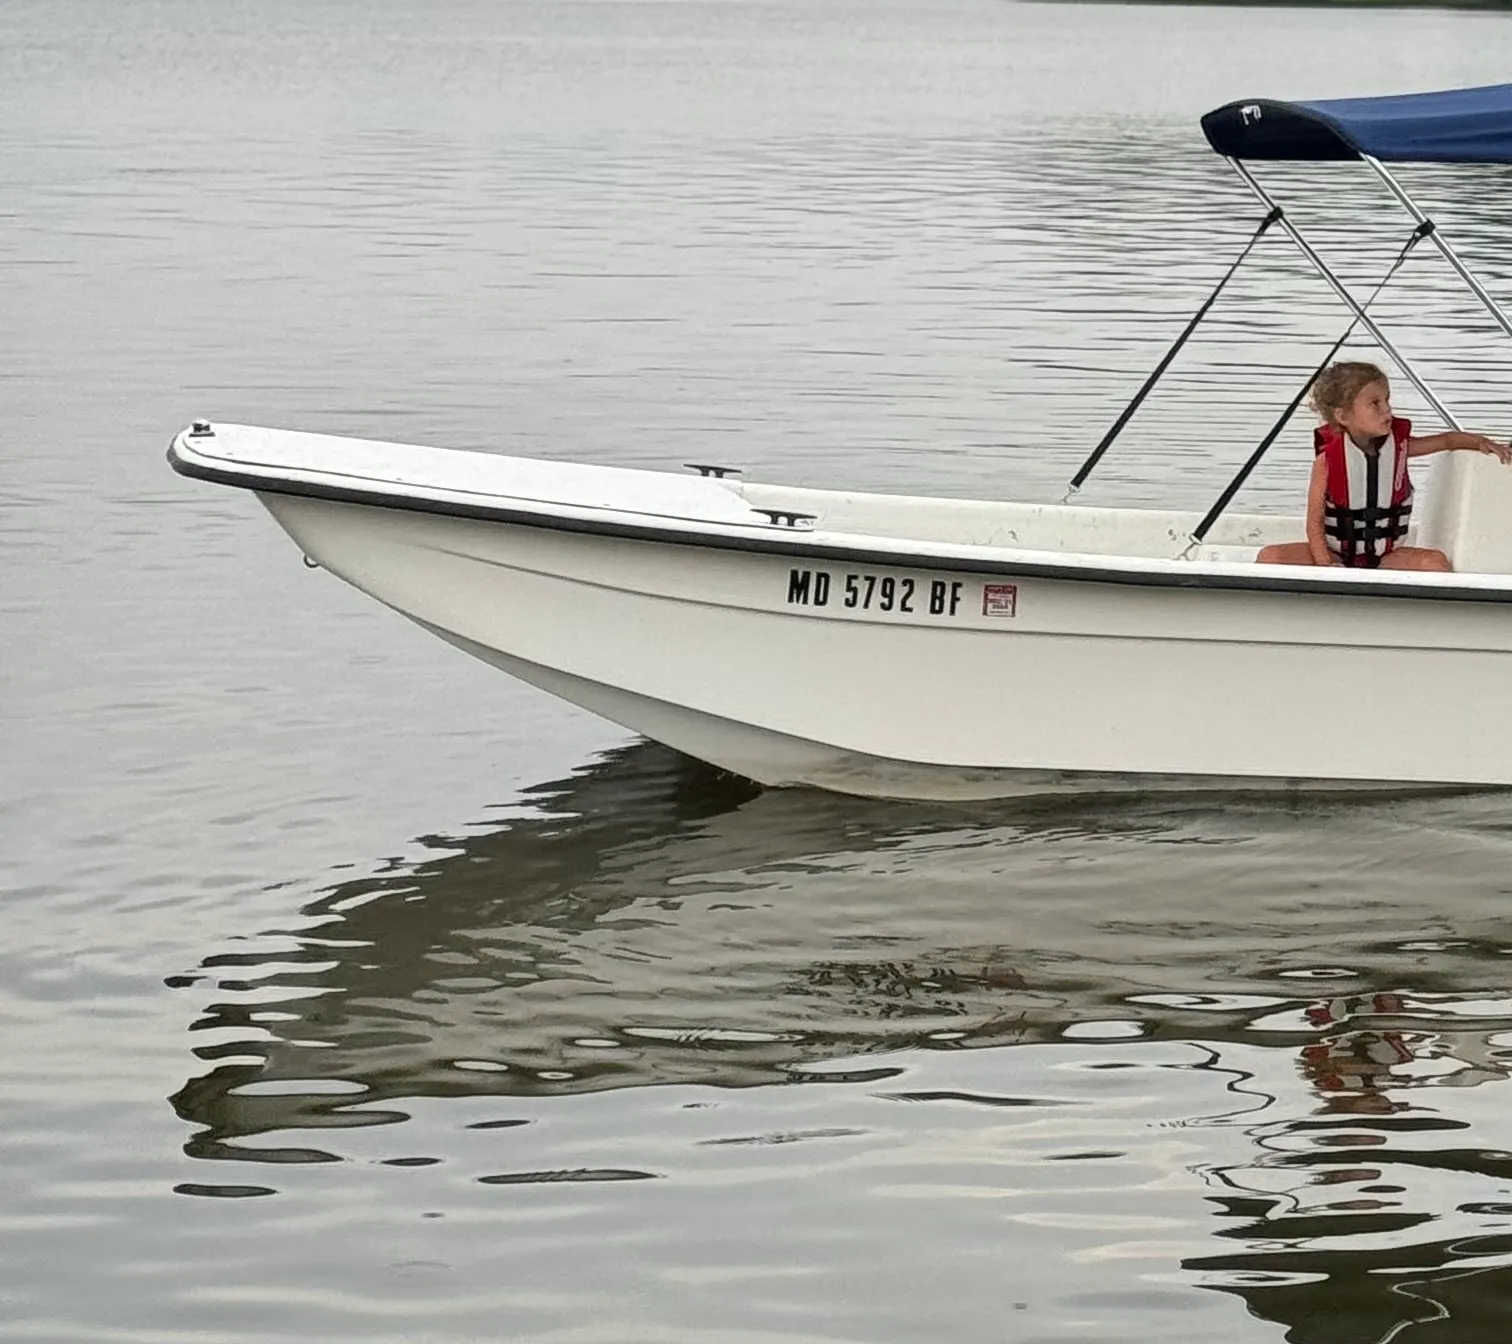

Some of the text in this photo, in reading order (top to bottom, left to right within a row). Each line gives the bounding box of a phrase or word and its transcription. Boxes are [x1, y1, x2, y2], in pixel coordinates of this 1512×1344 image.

[787, 569, 831, 606] MD
[844, 574, 915, 613] 5792
[929, 580, 963, 616] BF
